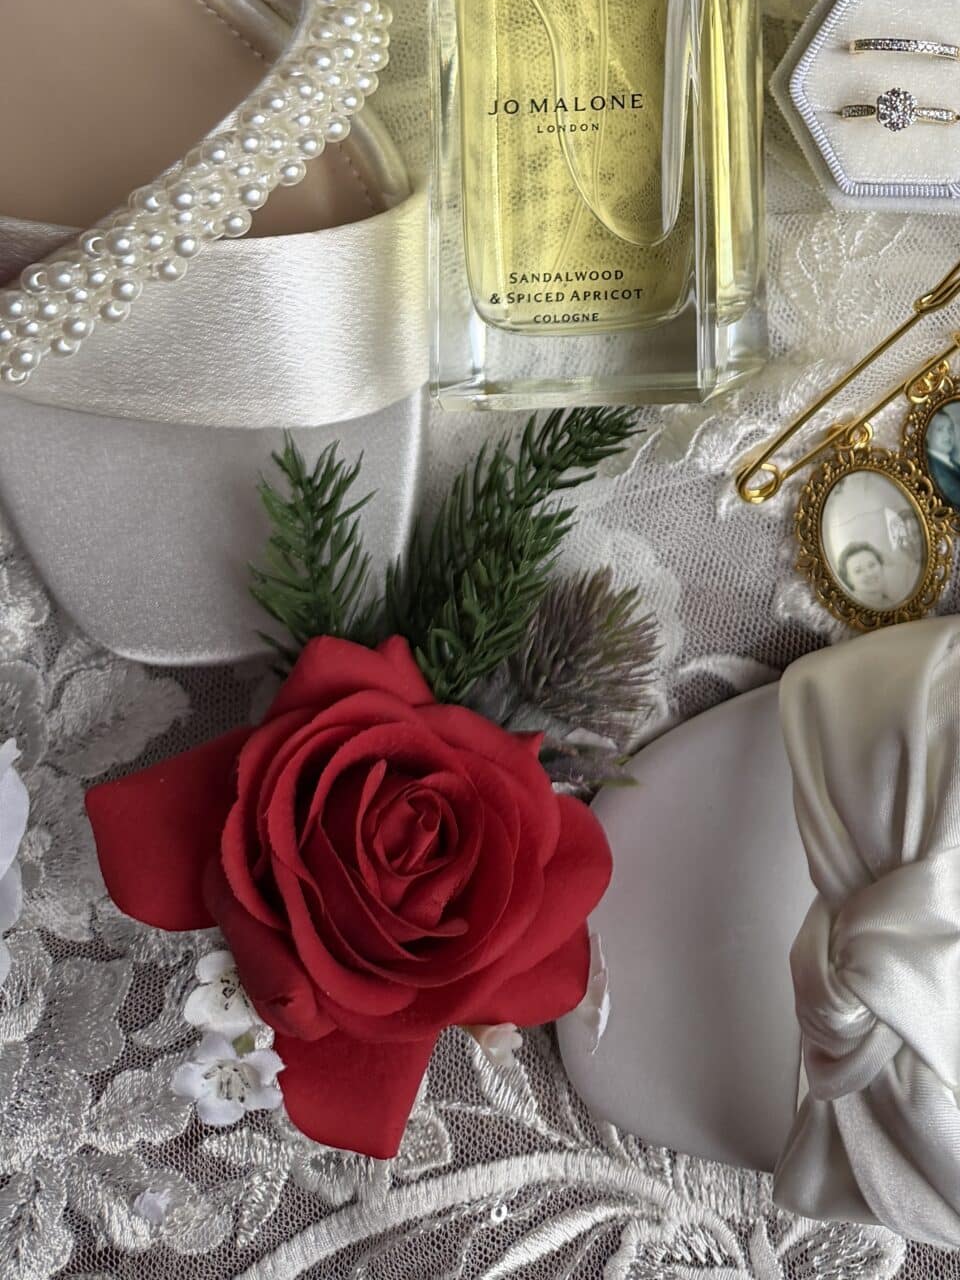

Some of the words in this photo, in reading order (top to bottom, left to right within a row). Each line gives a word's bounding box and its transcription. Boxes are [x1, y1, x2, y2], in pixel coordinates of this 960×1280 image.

[488, 99, 520, 116] JO
[530, 93, 643, 113] MALONE
[537, 123, 600, 134] LONDON
[509, 270, 624, 284] SANDALWOOD
[489, 293, 501, 305] &
[507, 292, 565, 304] SPICED
[570, 288, 643, 302] APRICOT
[533, 313, 600, 324] COLOGNE
